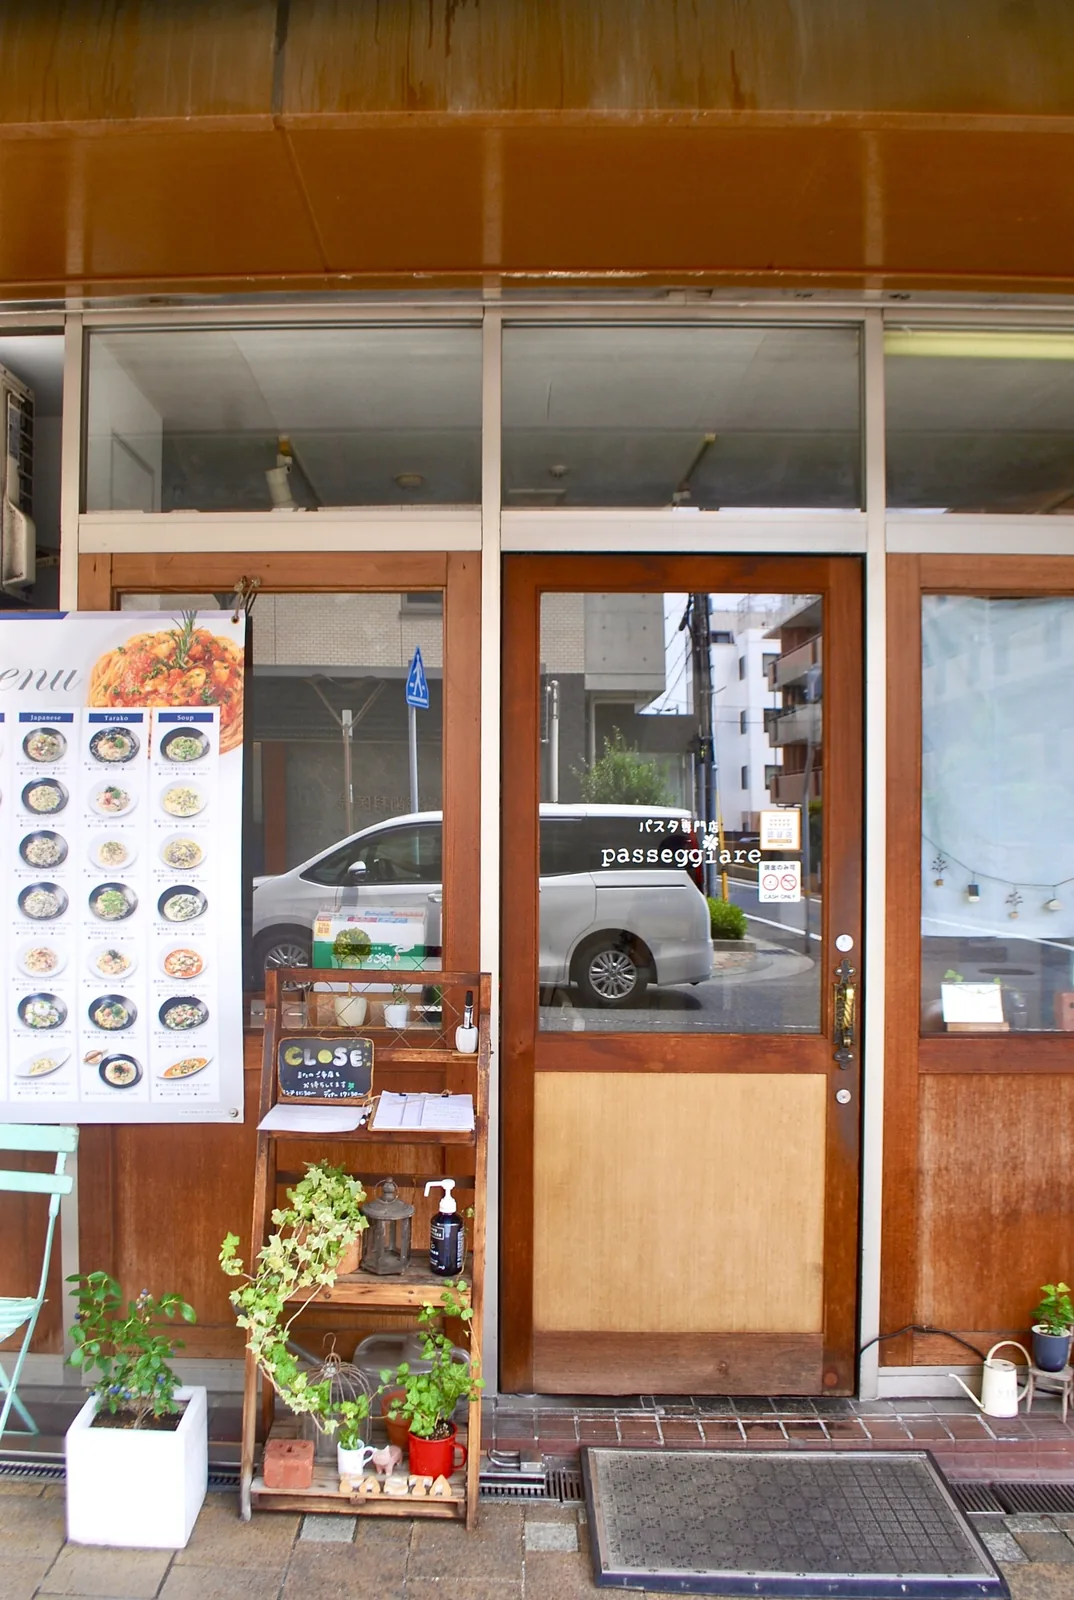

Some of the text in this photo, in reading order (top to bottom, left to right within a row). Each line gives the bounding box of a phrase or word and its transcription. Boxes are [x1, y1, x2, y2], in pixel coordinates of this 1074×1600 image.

[30, 714, 61, 722] Japanese
[104, 714, 129, 722] Tarako
[176, 714, 195, 722] Soup
[639, 819, 719, 834] パスタ専門店
[601, 846, 762, 868] passeggiare
[284, 1046, 364, 1067] CLOSE
[339, 1474, 452, 1497] PASTA
